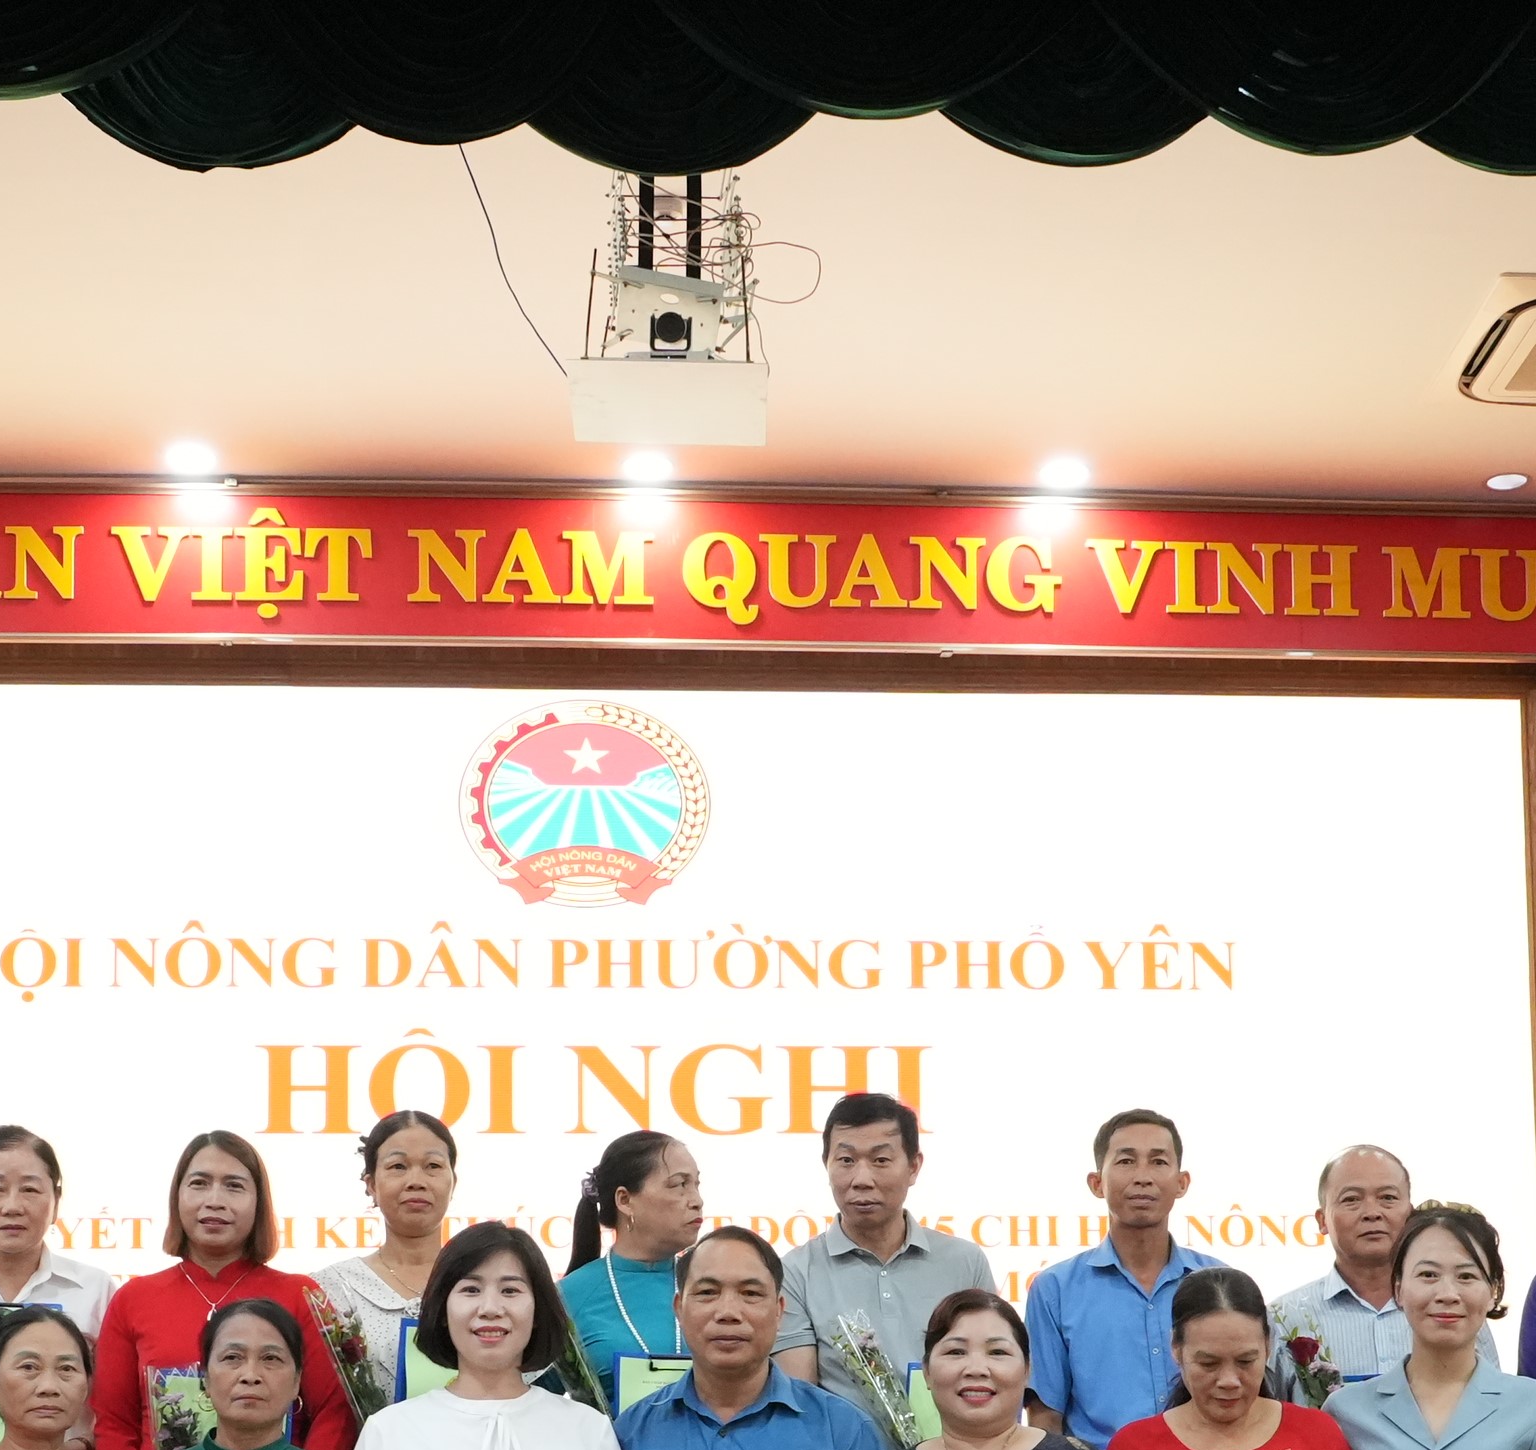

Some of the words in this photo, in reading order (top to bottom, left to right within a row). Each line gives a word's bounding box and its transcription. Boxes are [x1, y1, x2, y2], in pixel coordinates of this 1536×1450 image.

[110, 507, 373, 619] VIỆT
[407, 528, 656, 607] NAM
[682, 532, 1063, 626] QUANG
[1084, 538, 1360, 618] VINH
[529, 855, 556, 872] HỘI
[559, 849, 603, 862] NÔNG
[543, 864, 581, 877] VIỆT
[585, 864, 622, 878] NAM
[109, 919, 340, 988] NÔNG
[362, 920, 524, 988] DÂN
[548, 923, 884, 992] PHƯỜNG
[907, 923, 1065, 992] PHỔ
[1083, 923, 1237, 992] YÊN
[315, 1206, 383, 1250] KẾ
[971, 1214, 1059, 1248] CHI
[1184, 1203, 1326, 1248] NÔNG
